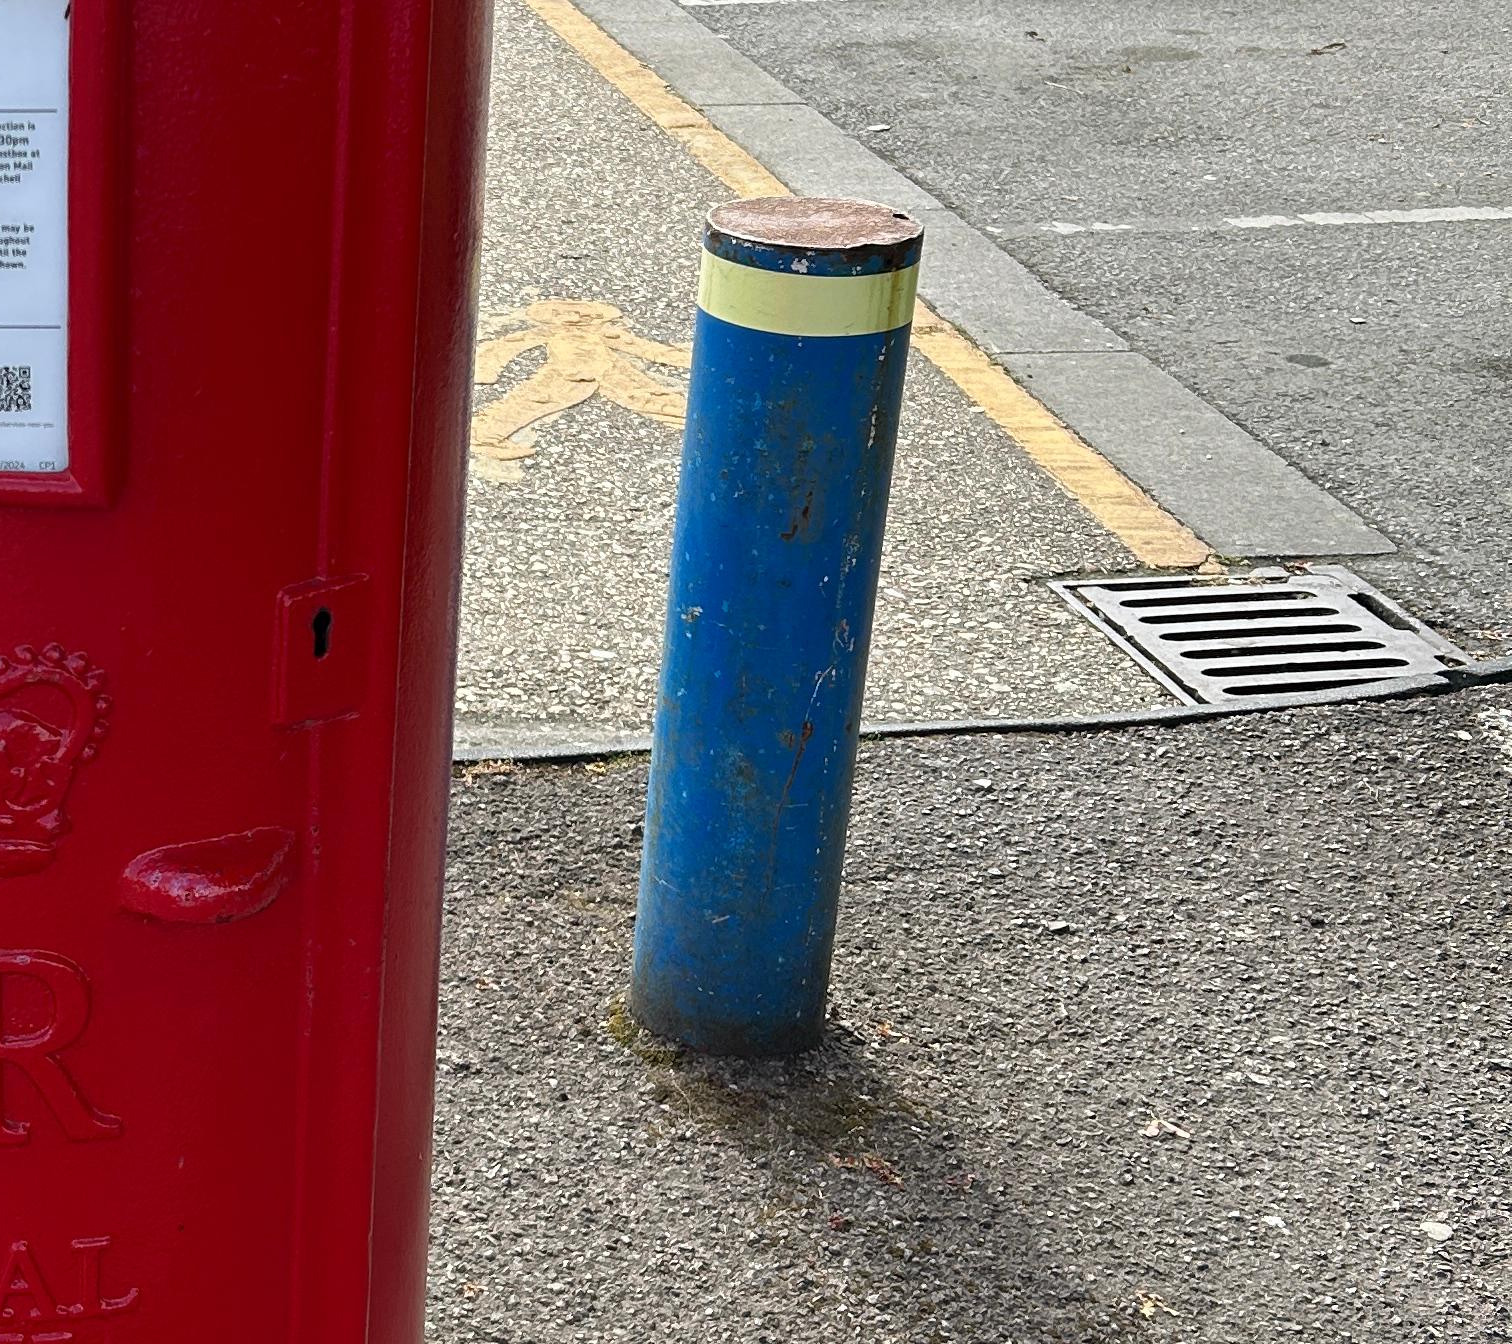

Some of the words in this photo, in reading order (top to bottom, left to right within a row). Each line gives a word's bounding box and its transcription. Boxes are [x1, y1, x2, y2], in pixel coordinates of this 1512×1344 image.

[28, 121, 36, 131] is
[31, 149, 40, 158] at
[13, 161, 33, 171] Mail
[1, 225, 20, 234] may
[24, 223, 34, 233] be
[12, 248, 27, 257] the
